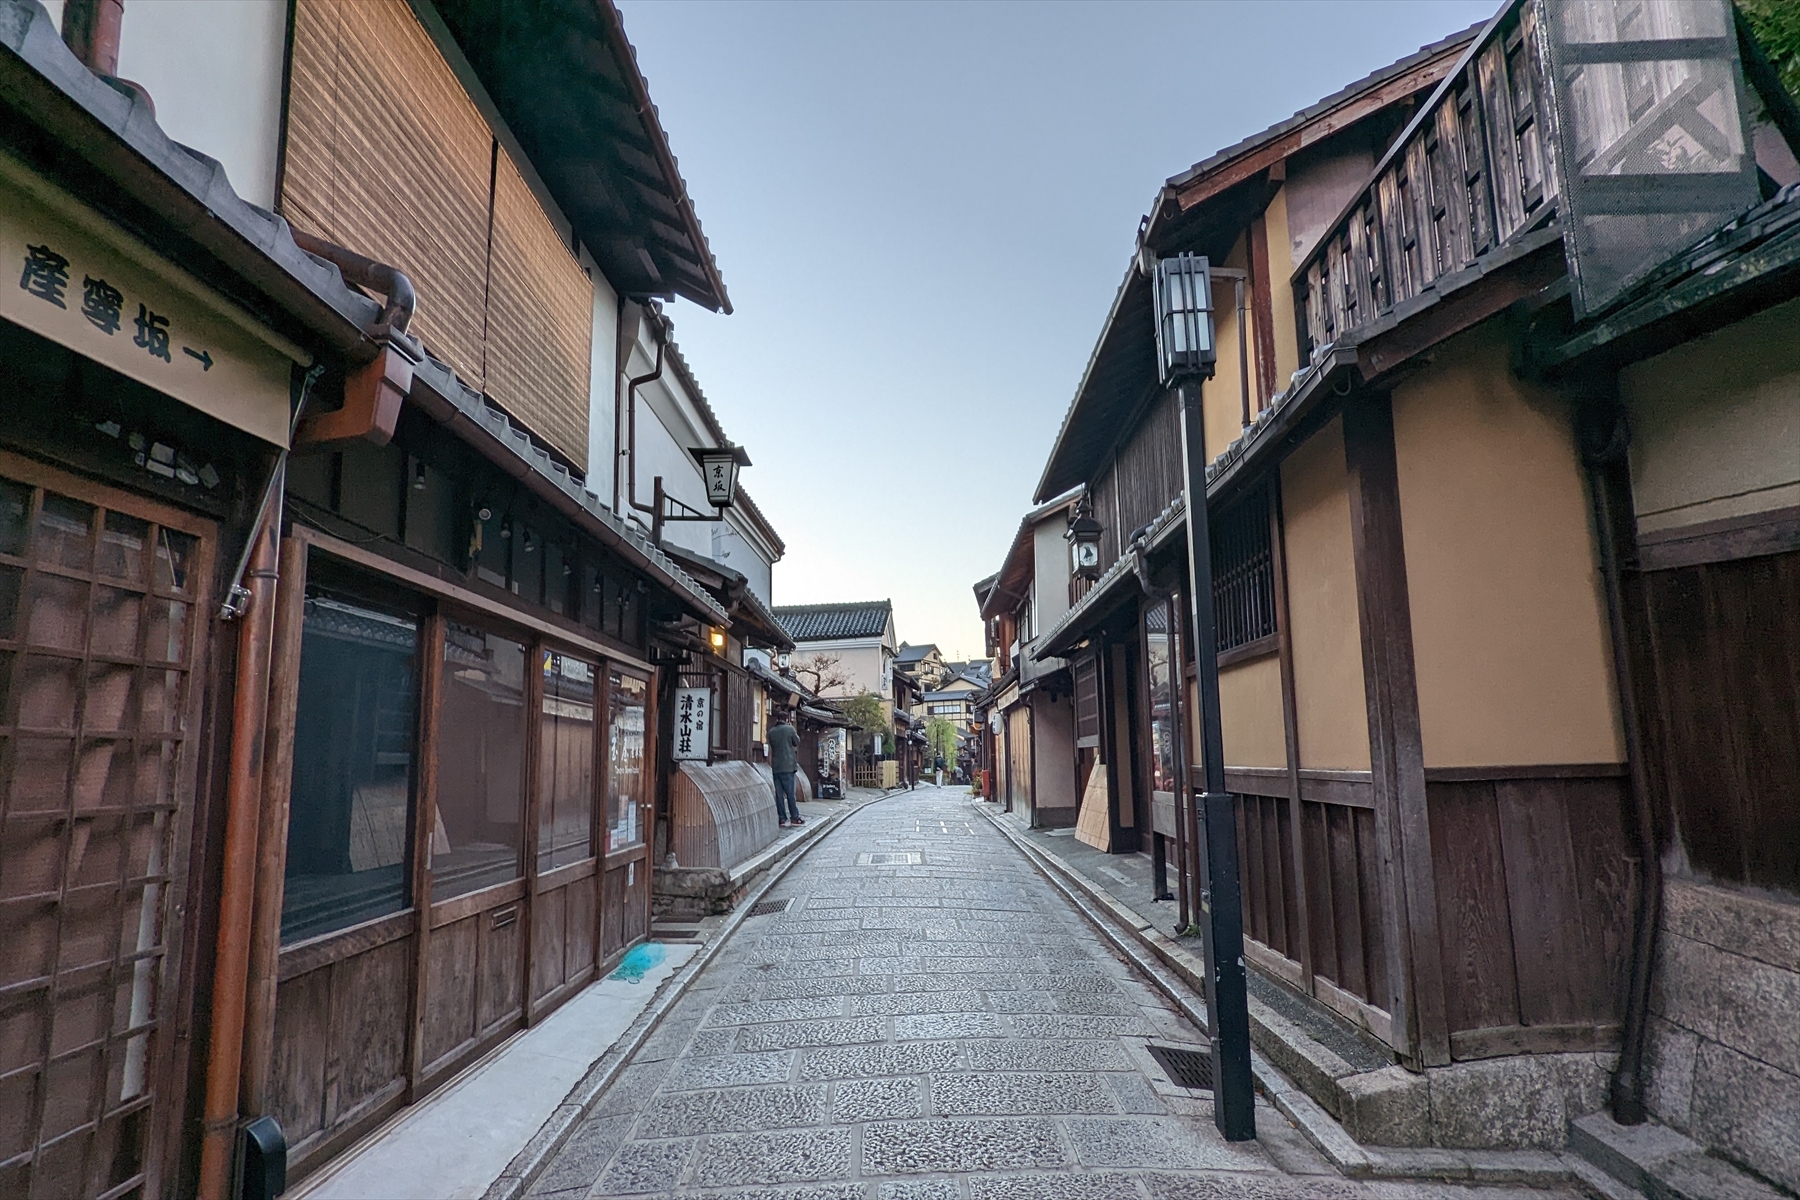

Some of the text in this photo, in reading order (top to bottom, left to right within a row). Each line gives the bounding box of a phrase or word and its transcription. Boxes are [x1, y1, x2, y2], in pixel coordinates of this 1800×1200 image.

[20, 244, 171, 363] 産寧坂
[713, 465, 726, 492] 京坂
[679, 694, 694, 754] 清水山荘
[695, 697, 705, 731] 京の宿
